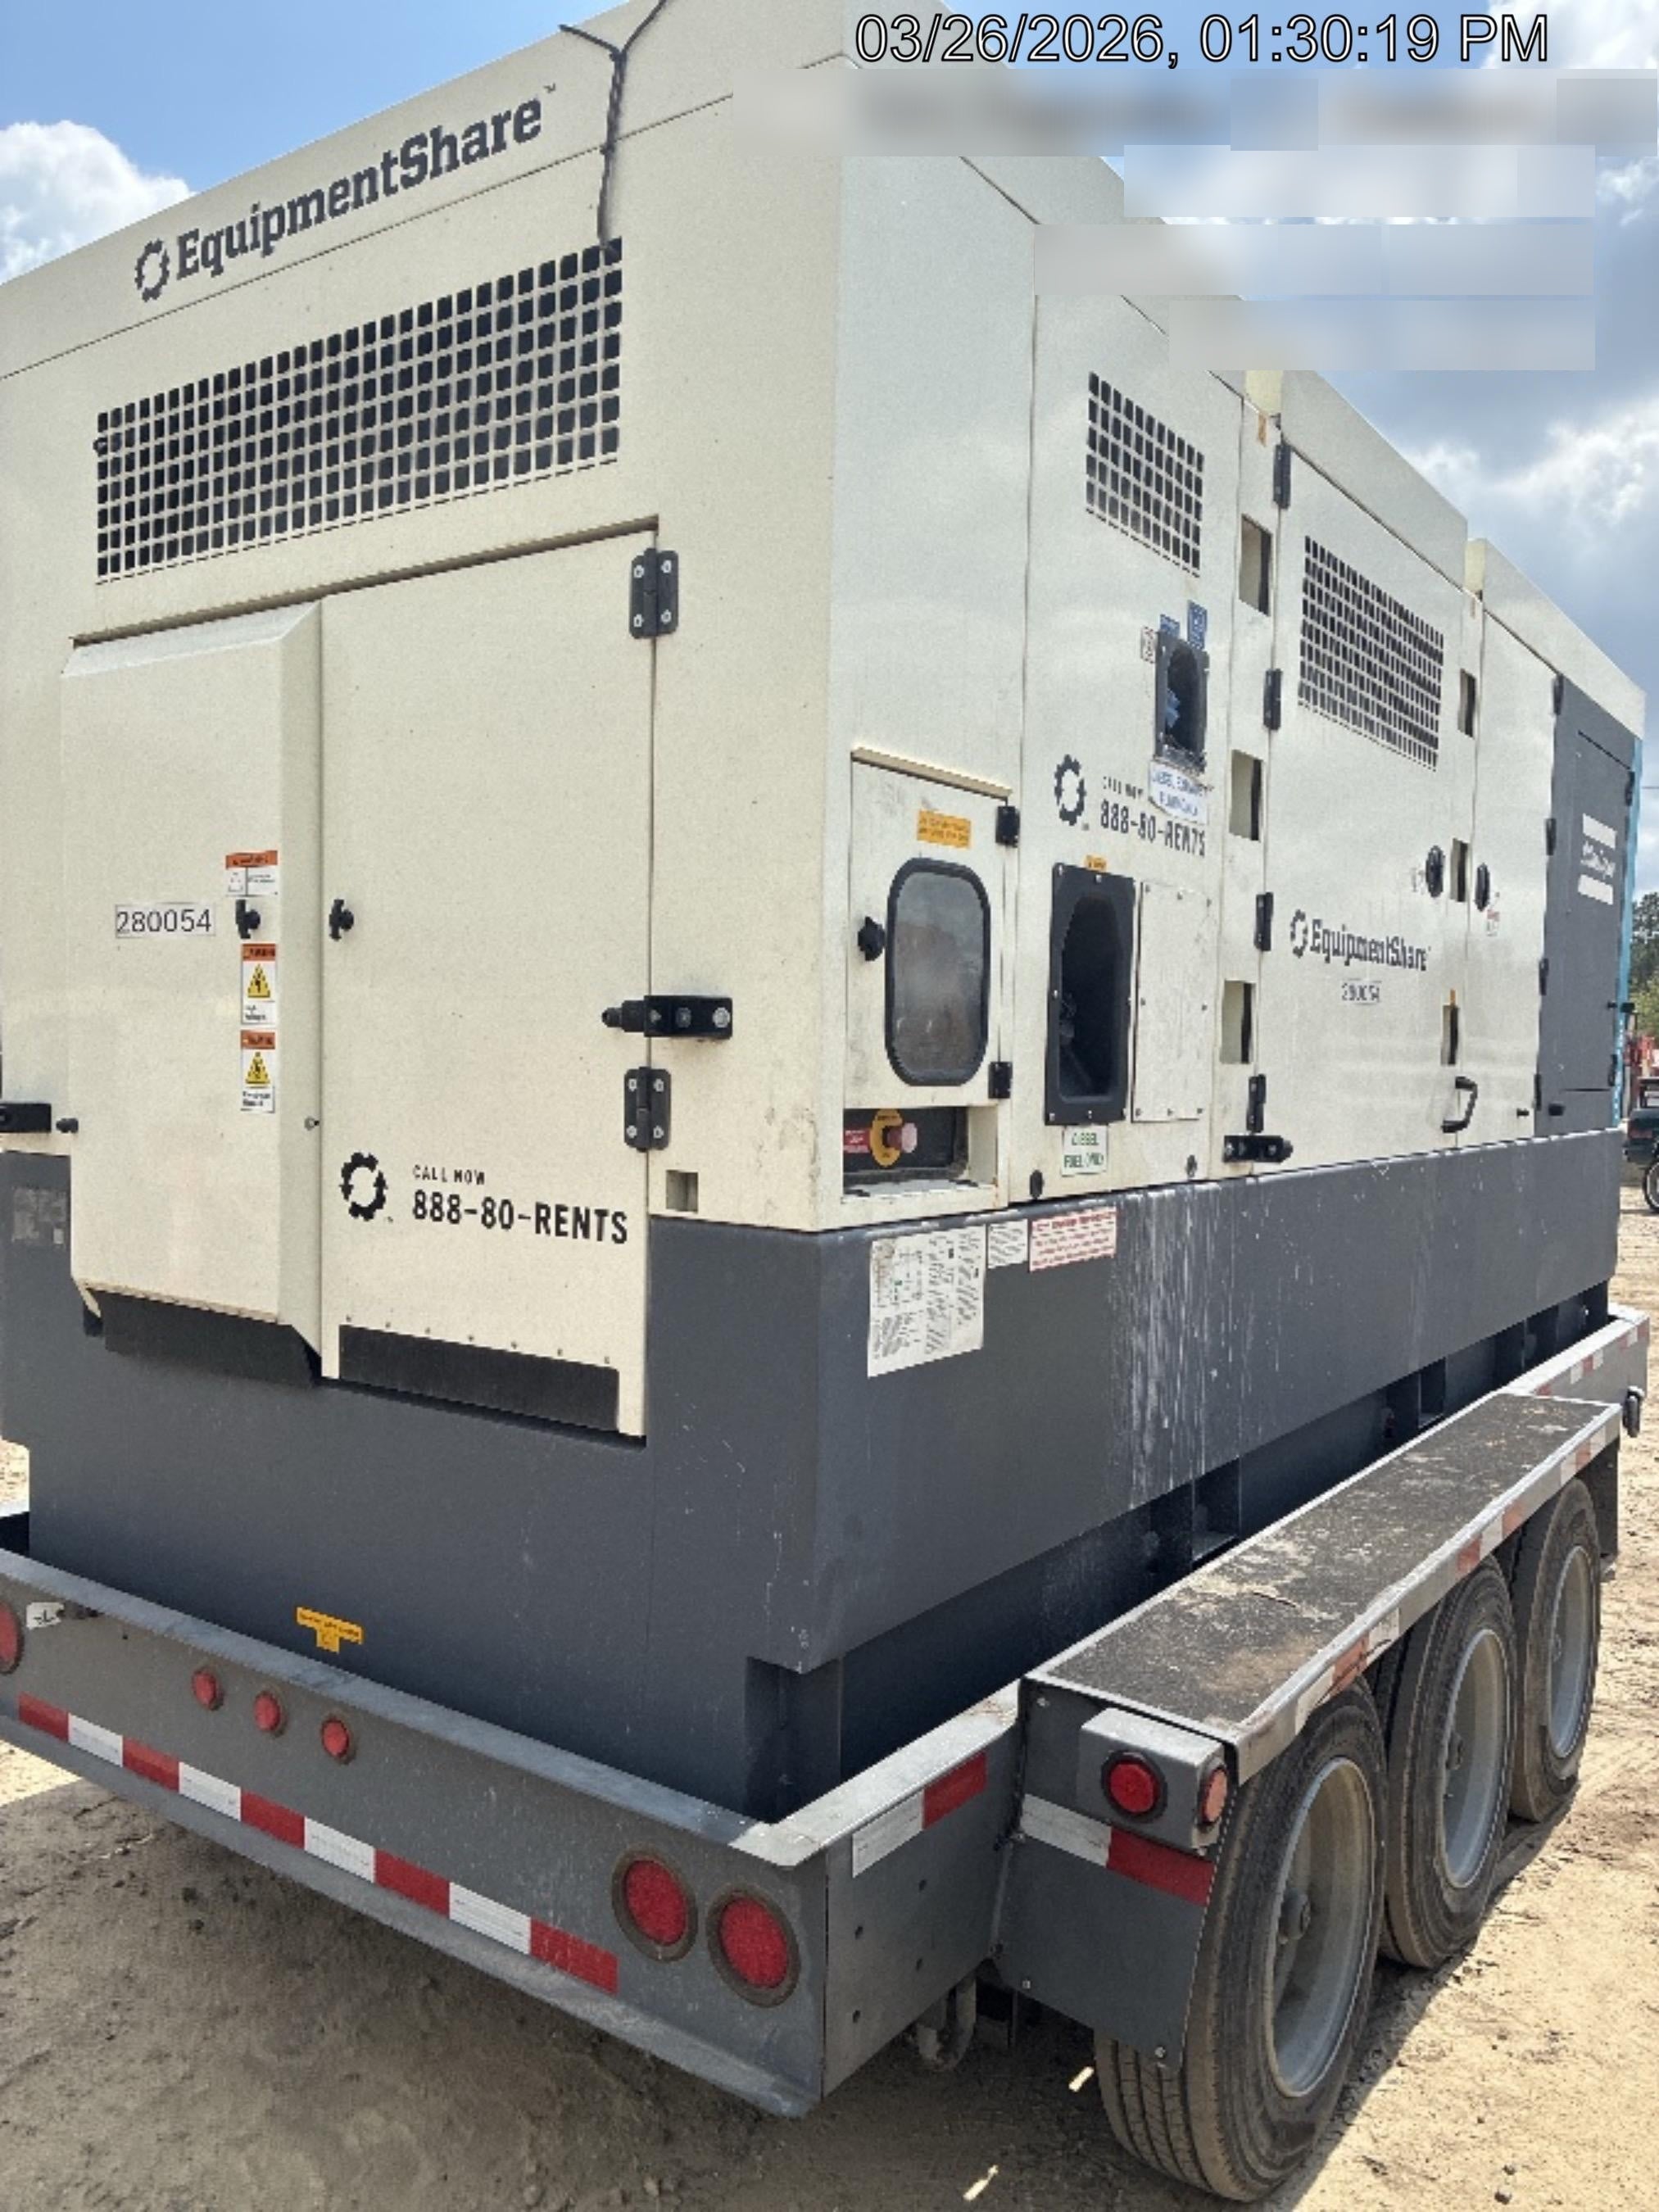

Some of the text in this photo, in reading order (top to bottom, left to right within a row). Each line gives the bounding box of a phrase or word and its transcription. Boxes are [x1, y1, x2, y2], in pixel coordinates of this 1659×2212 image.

[176, 95, 542, 279] EquipmentShare
[117, 908, 211, 932] 280054
[1310, 918, 1427, 972] EquipmentShare
[412, 1164, 448, 1183] CALL
[412, 1189, 628, 1244] 888-80-RENTS
